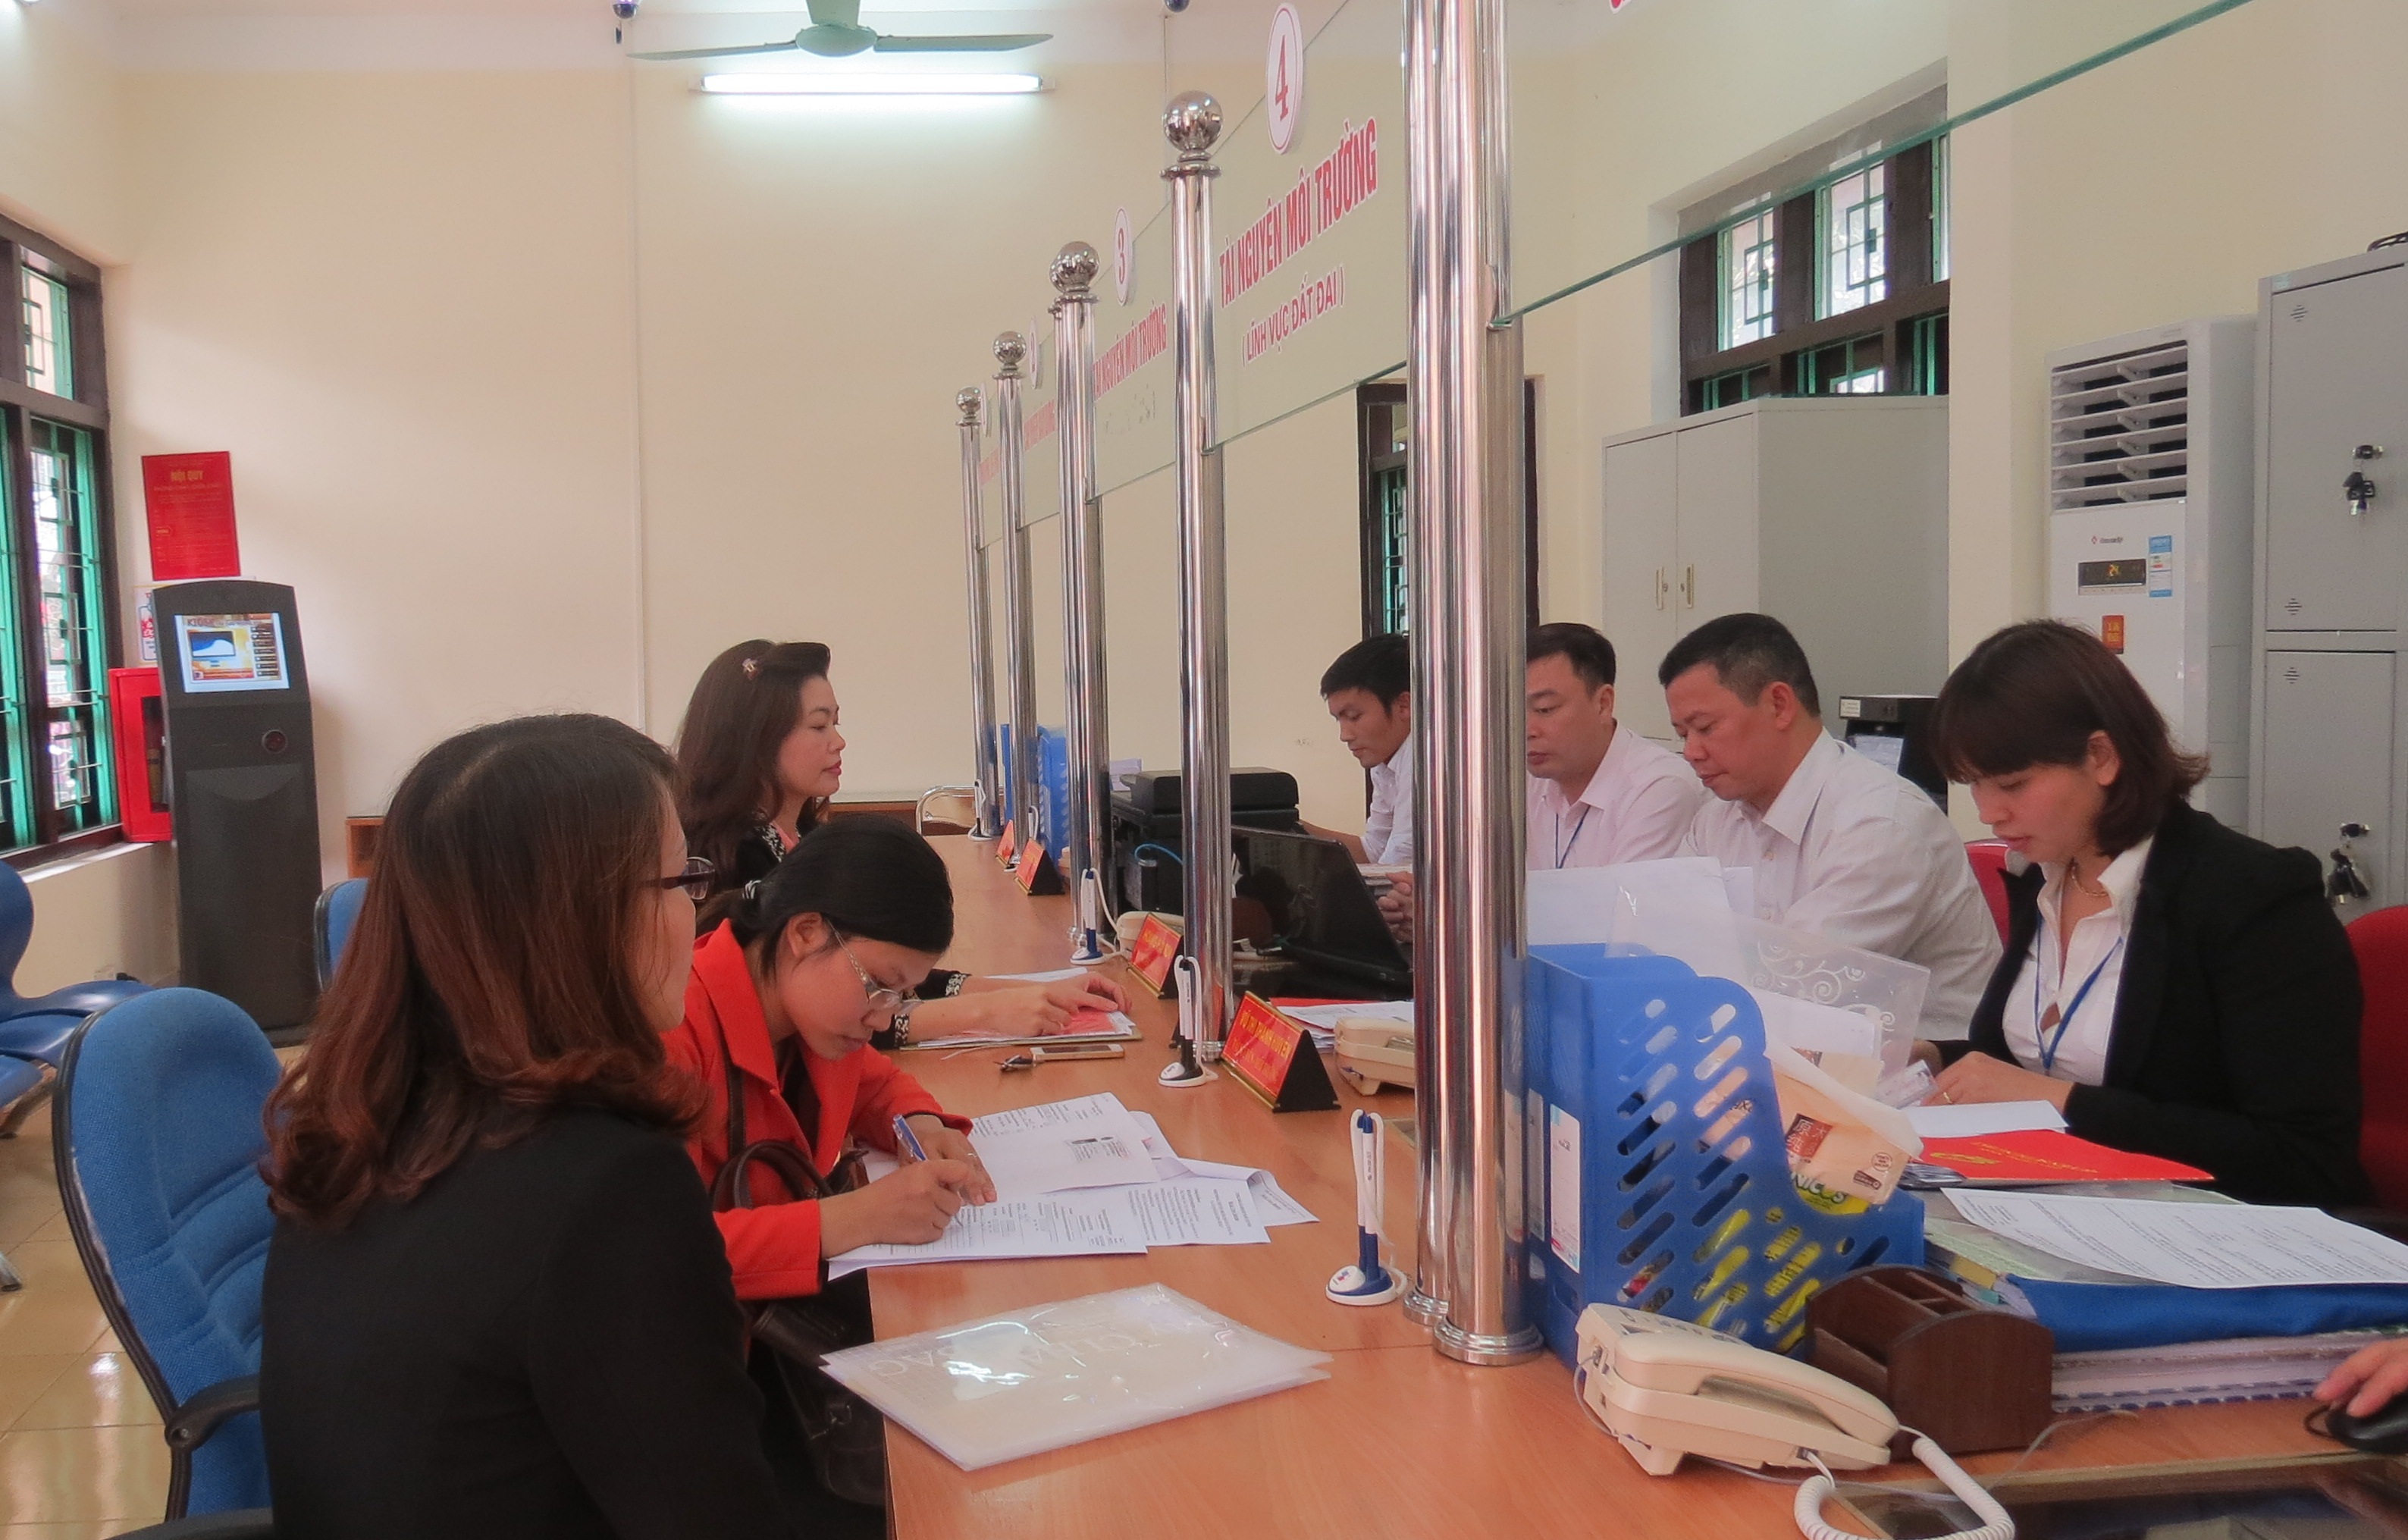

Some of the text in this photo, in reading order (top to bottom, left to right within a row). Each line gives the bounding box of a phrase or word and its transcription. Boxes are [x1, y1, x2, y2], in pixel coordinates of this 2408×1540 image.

[1275, 34, 1289, 121] 4
[1219, 118, 1377, 309] TÀI NGUYÊN MÔI TRƯỜNG
[1118, 227, 1126, 284] 3
[1291, 273, 1313, 331] ĐẤT
[1316, 269, 1337, 315] ĐAI
